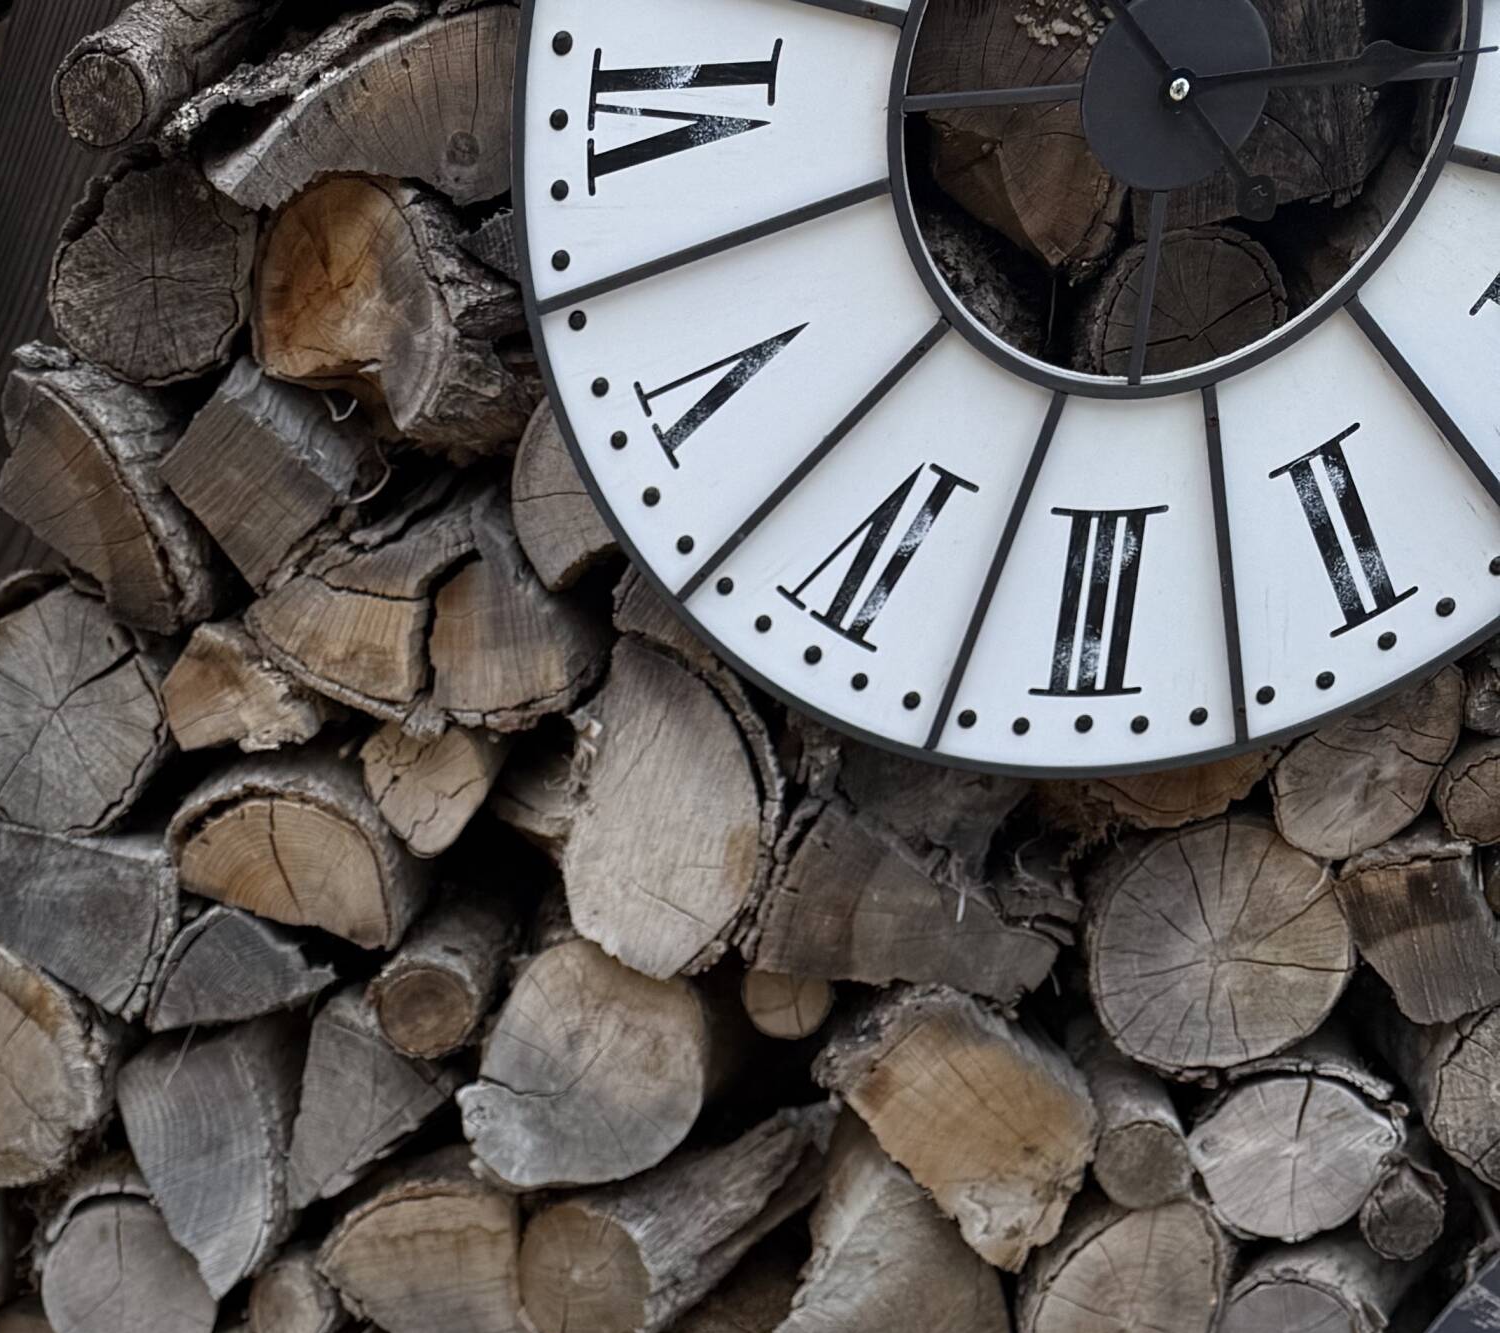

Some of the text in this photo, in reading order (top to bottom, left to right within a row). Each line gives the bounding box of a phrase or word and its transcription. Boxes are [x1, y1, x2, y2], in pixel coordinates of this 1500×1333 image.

[633, 322, 809, 469] V
[1028, 504, 1169, 697] III
[1268, 421, 1419, 637] II
